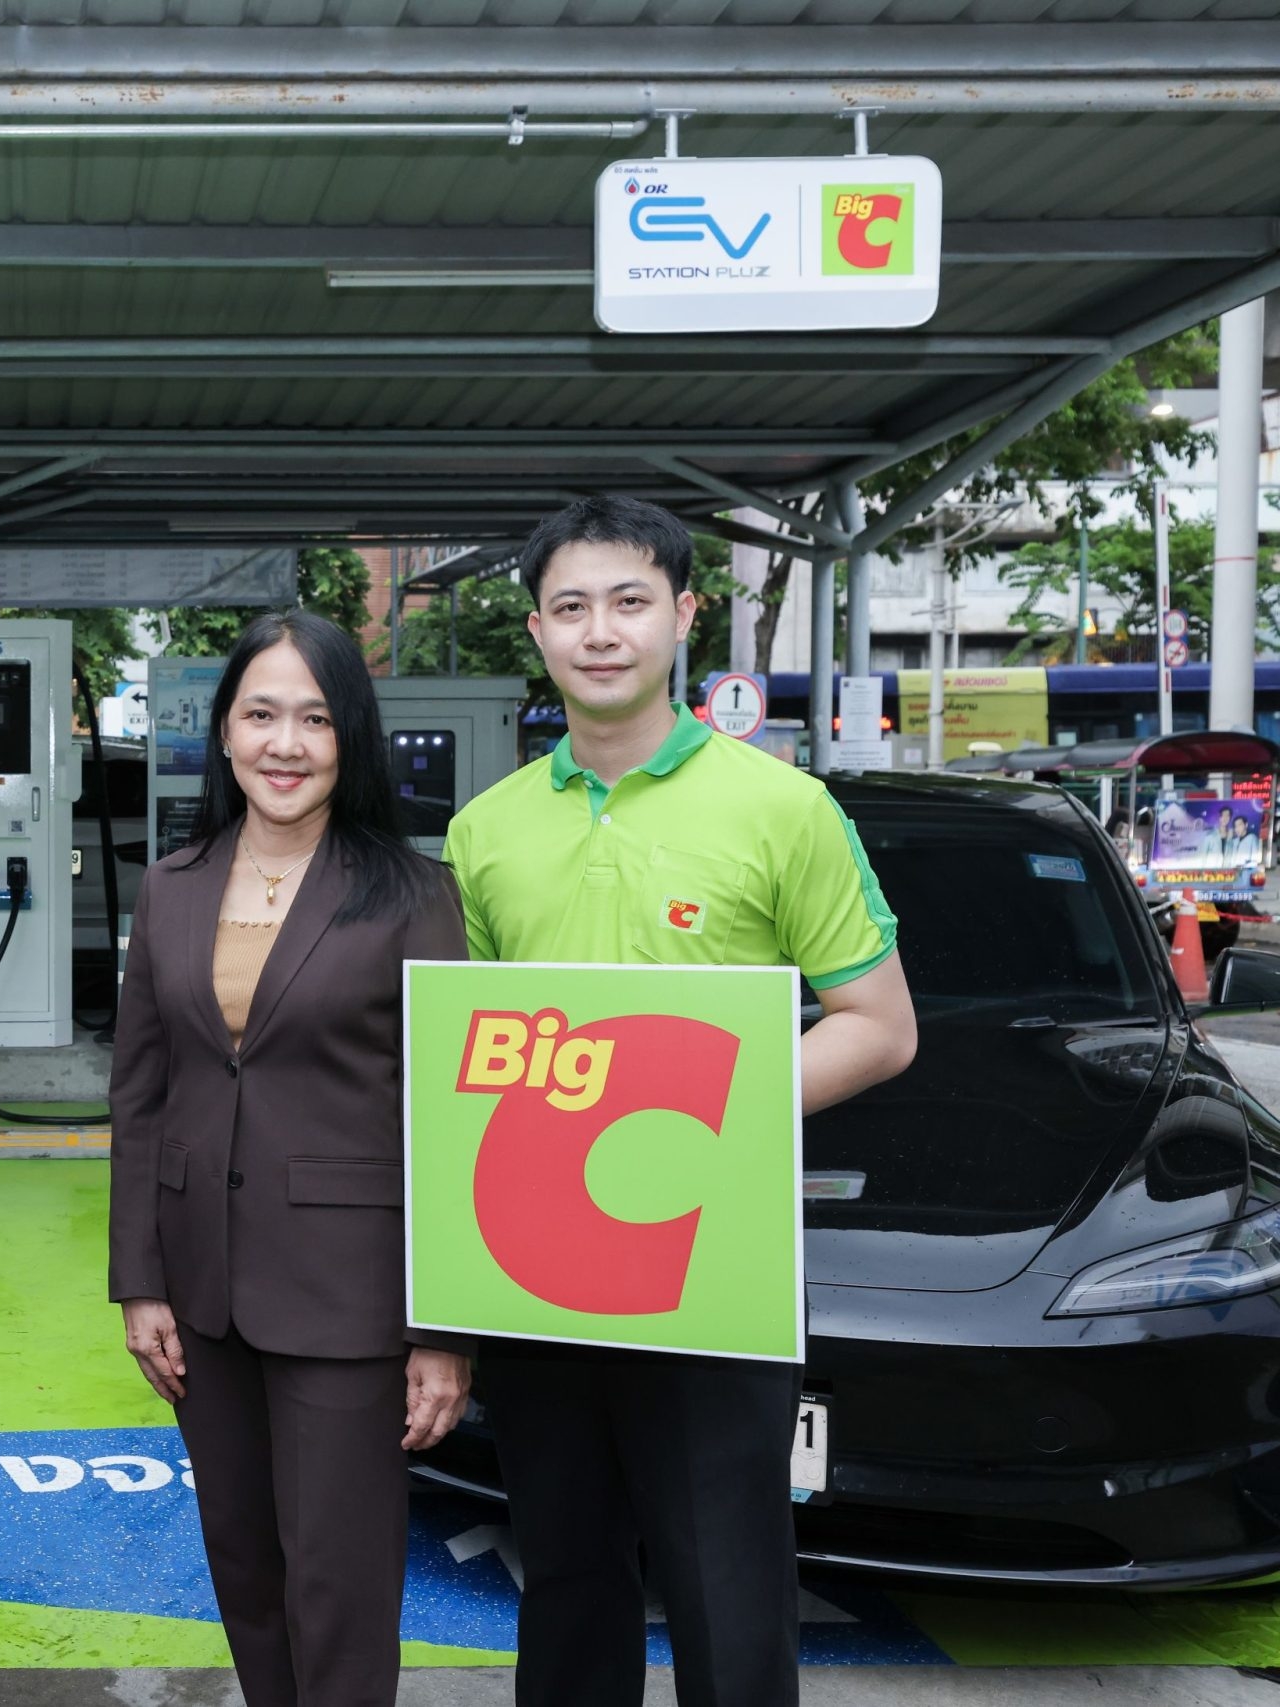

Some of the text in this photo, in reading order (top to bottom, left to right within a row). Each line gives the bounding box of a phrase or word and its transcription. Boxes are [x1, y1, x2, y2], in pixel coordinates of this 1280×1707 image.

[644, 184, 668, 194] OR
[835, 194, 874, 220] Big
[629, 196, 771, 260] EV
[837, 194, 903, 269] C
[628, 265, 771, 279] STATION PLUZ
[726, 719, 747, 731] EXIT
[668, 903, 700, 928] C
[669, 900, 687, 911] Big
[465, 1015, 616, 1112] Big
[472, 1013, 741, 1316] C
